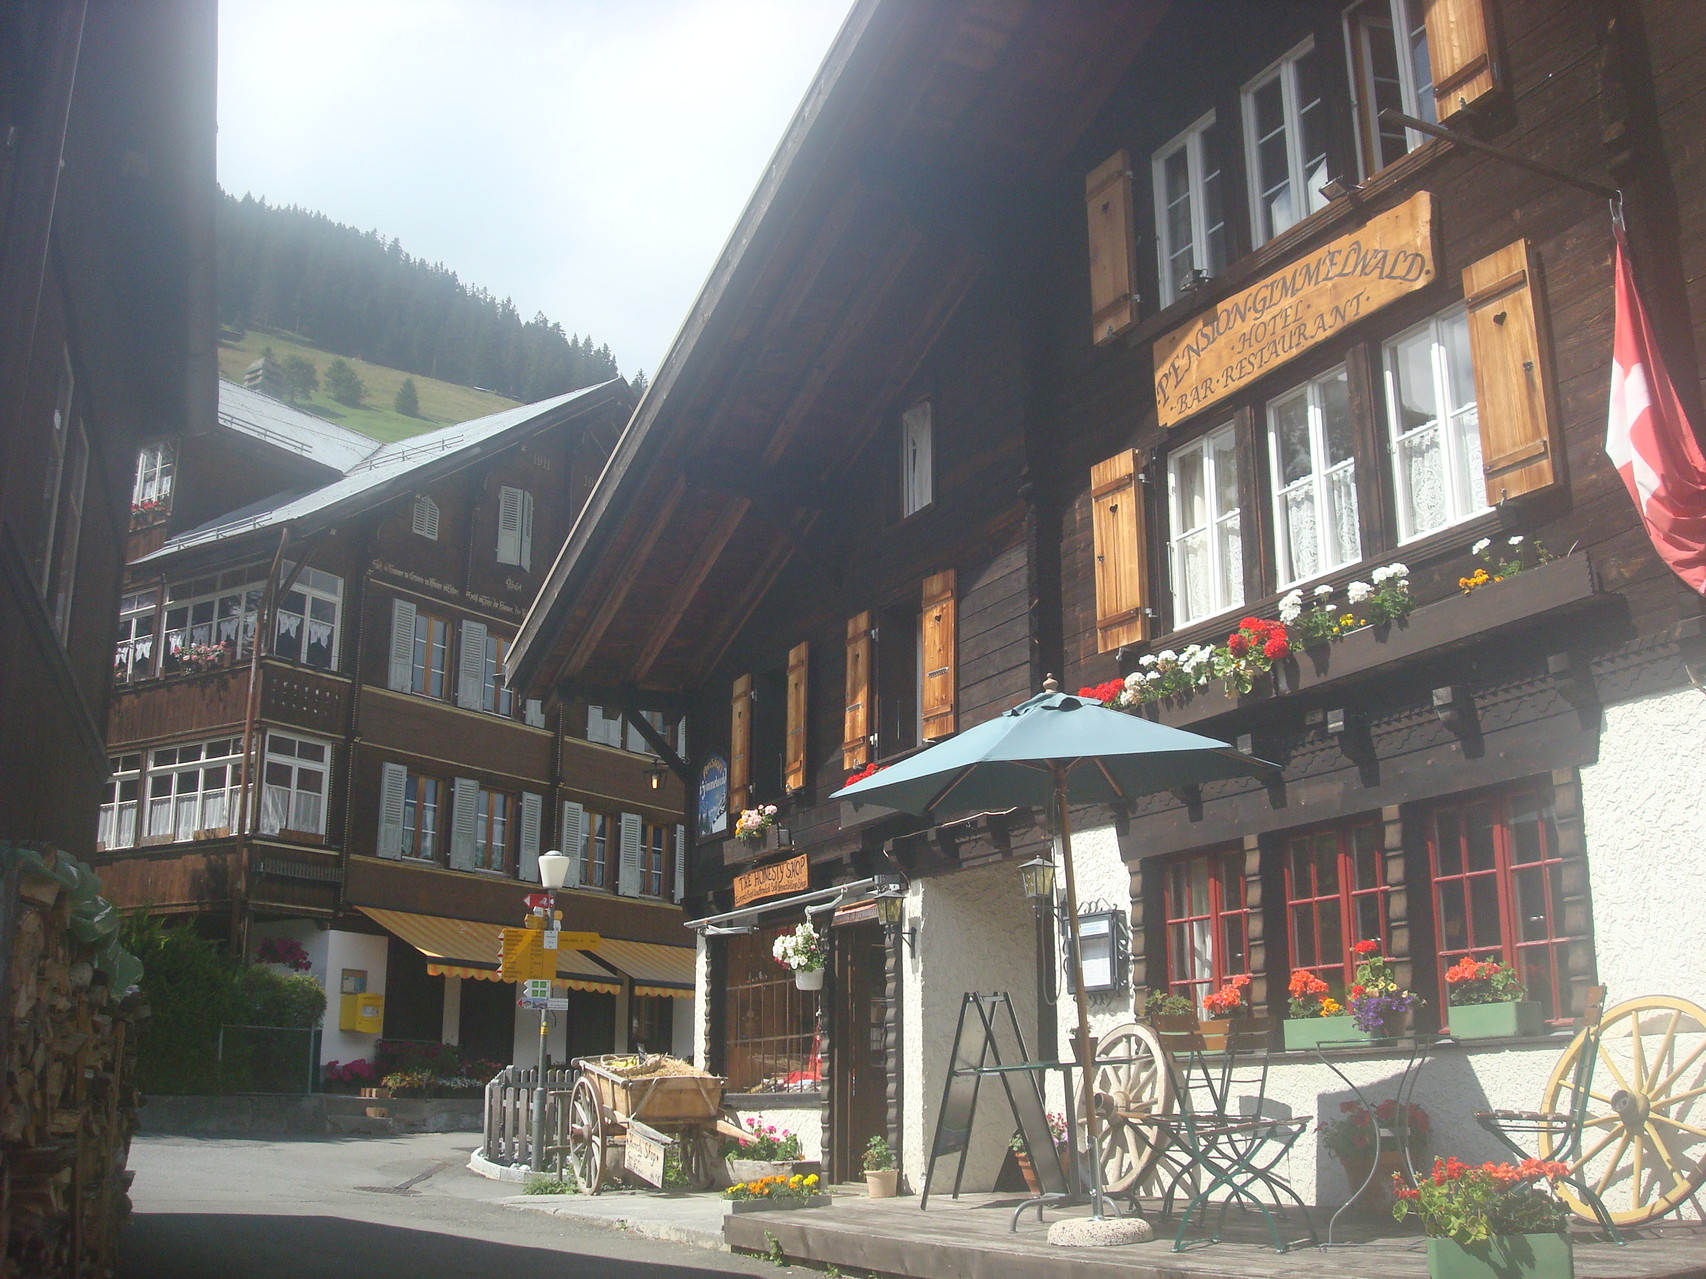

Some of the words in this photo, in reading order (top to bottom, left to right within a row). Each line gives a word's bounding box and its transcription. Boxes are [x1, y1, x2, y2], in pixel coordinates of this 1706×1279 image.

[1158, 298, 1251, 406] PENSION
[1252, 240, 1426, 320] GIMMELWALD
[1177, 377, 1214, 415] BAR
[1223, 288, 1367, 389] RESTAURANT
[1237, 300, 1304, 355] HOTEL
[739, 872, 752, 890] THE
[754, 864, 784, 887] HONESTY
[786, 857, 805, 879] SHOP
